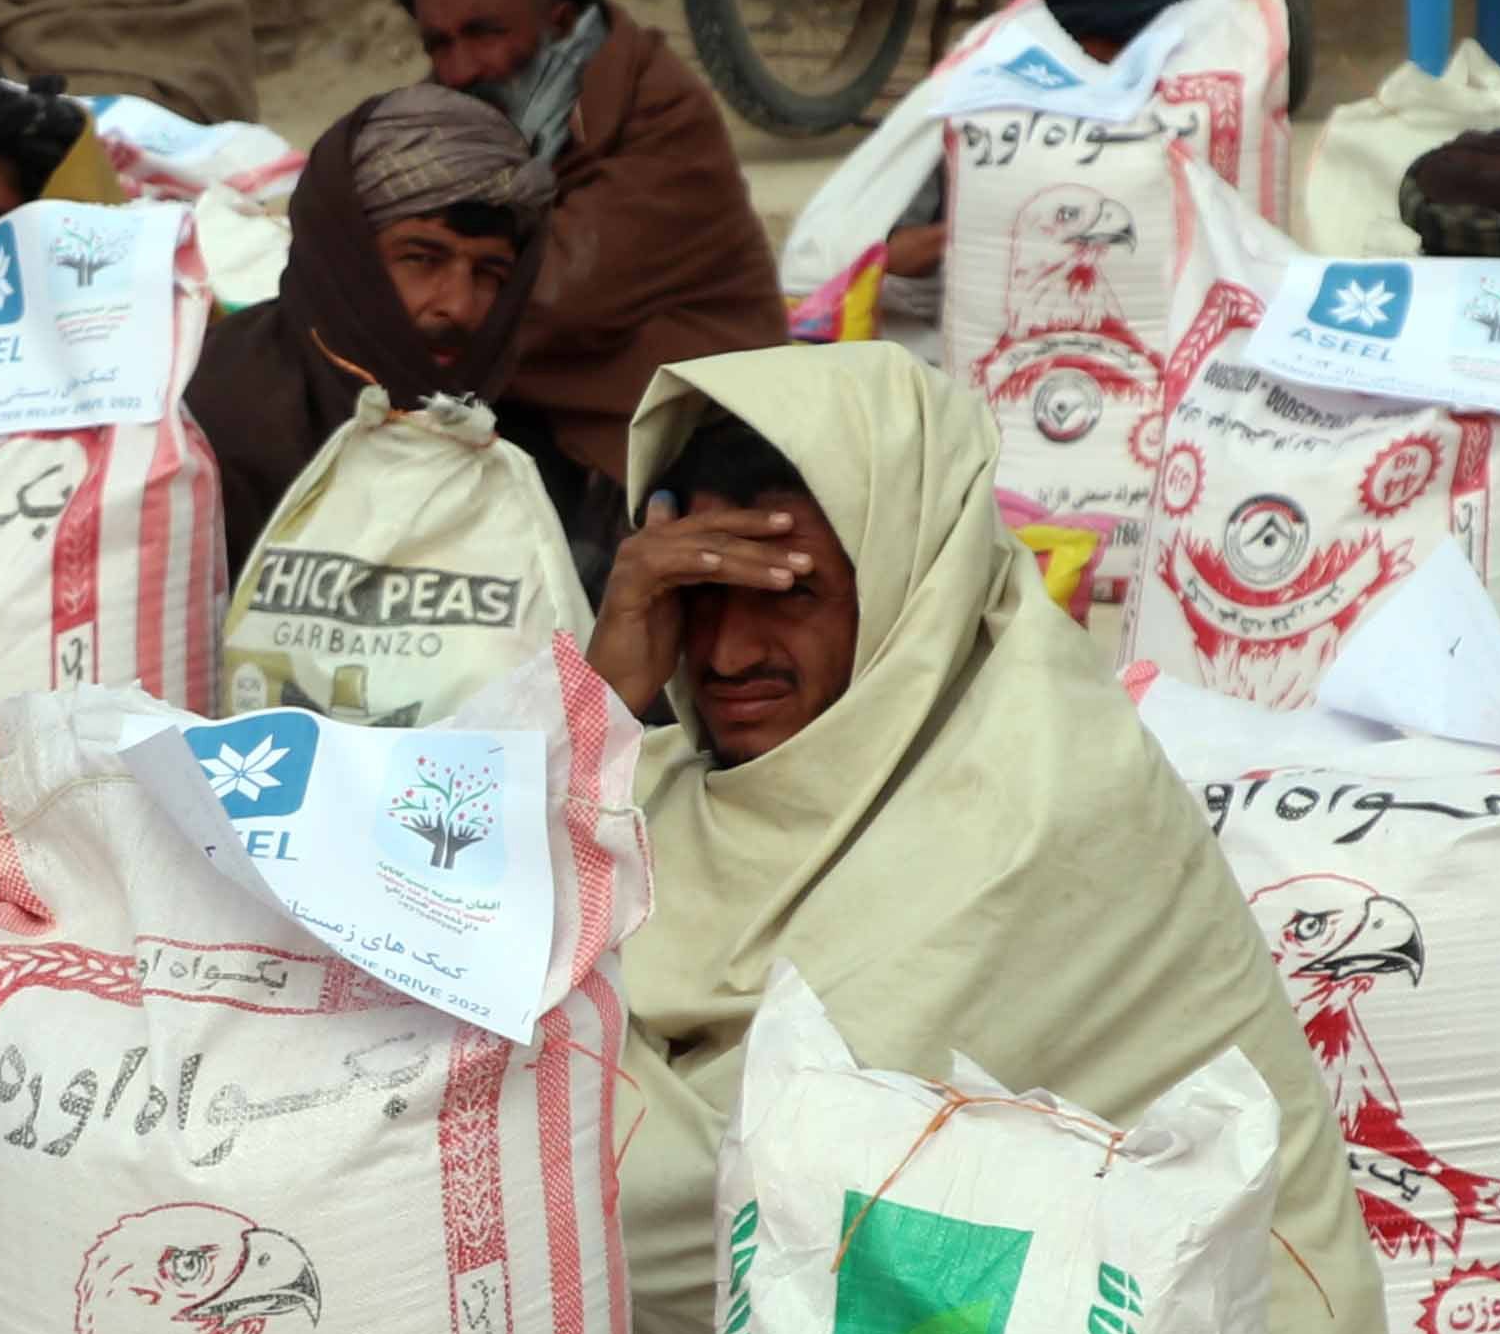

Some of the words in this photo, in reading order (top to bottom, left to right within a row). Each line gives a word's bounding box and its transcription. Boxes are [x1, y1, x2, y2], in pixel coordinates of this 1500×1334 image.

[1291, 328, 1393, 363] ASEEL
[250, 554, 368, 619] CHICK
[380, 574, 514, 622] PEAS
[272, 622, 444, 657] GARBANZO
[360, 932, 405, 955] های
[412, 949, 469, 980] کمک
[384, 968, 443, 998] DRIVE
[447, 994, 492, 1018] 2022
